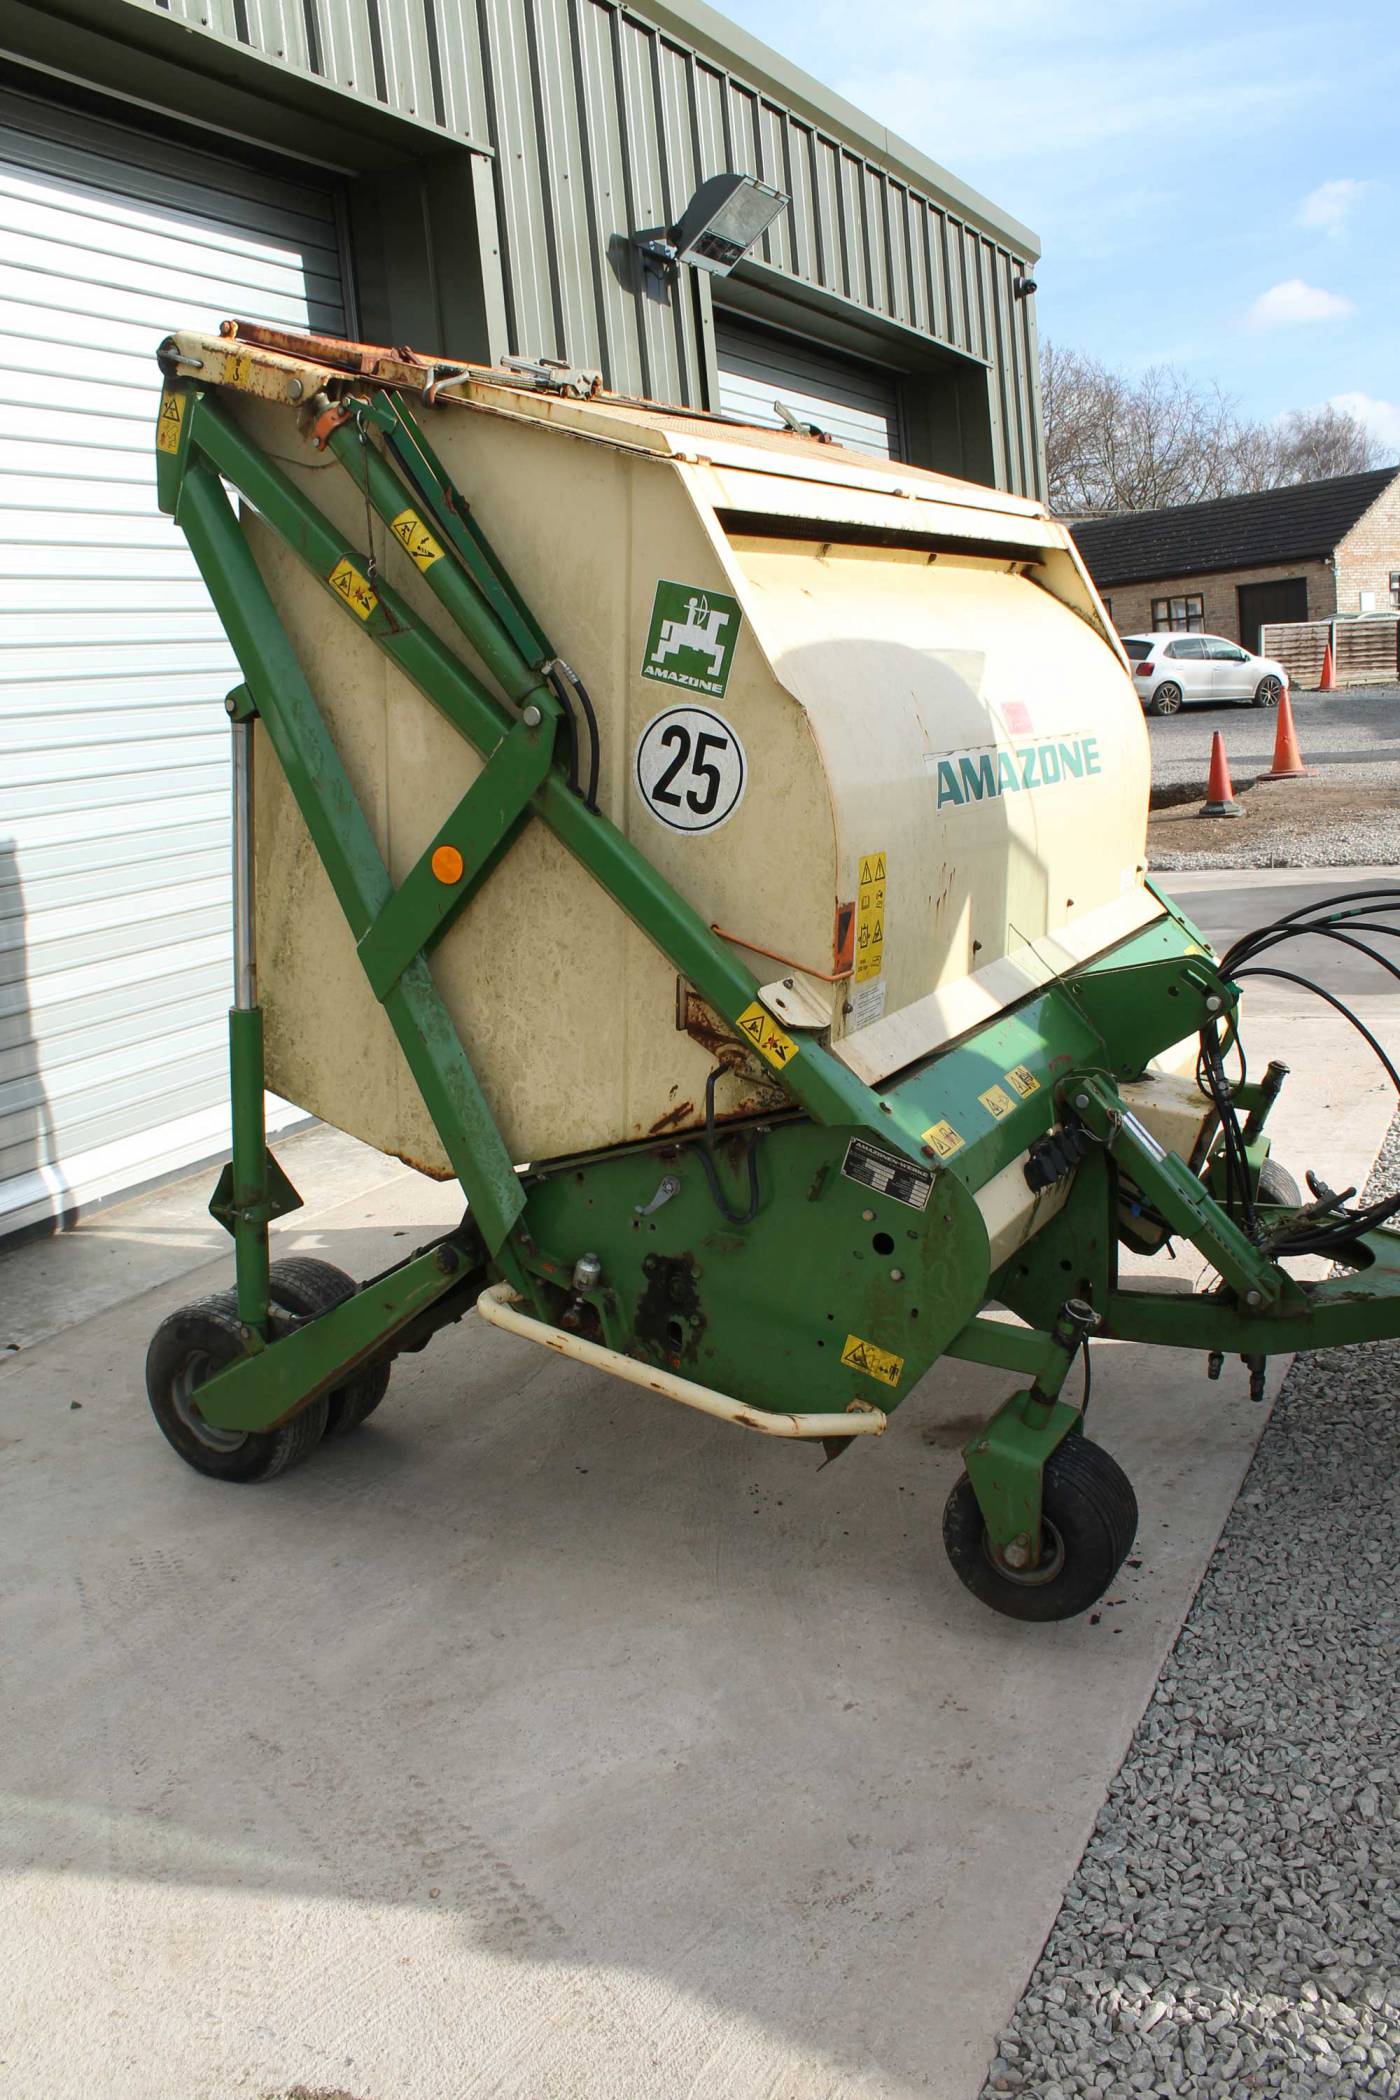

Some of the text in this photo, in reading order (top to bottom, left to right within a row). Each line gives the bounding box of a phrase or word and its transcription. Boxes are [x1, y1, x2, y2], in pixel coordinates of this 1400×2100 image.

[644, 665, 723, 694] AMAZONE
[651, 724, 728, 815] 25
[937, 737, 1102, 810] AMAZONE
